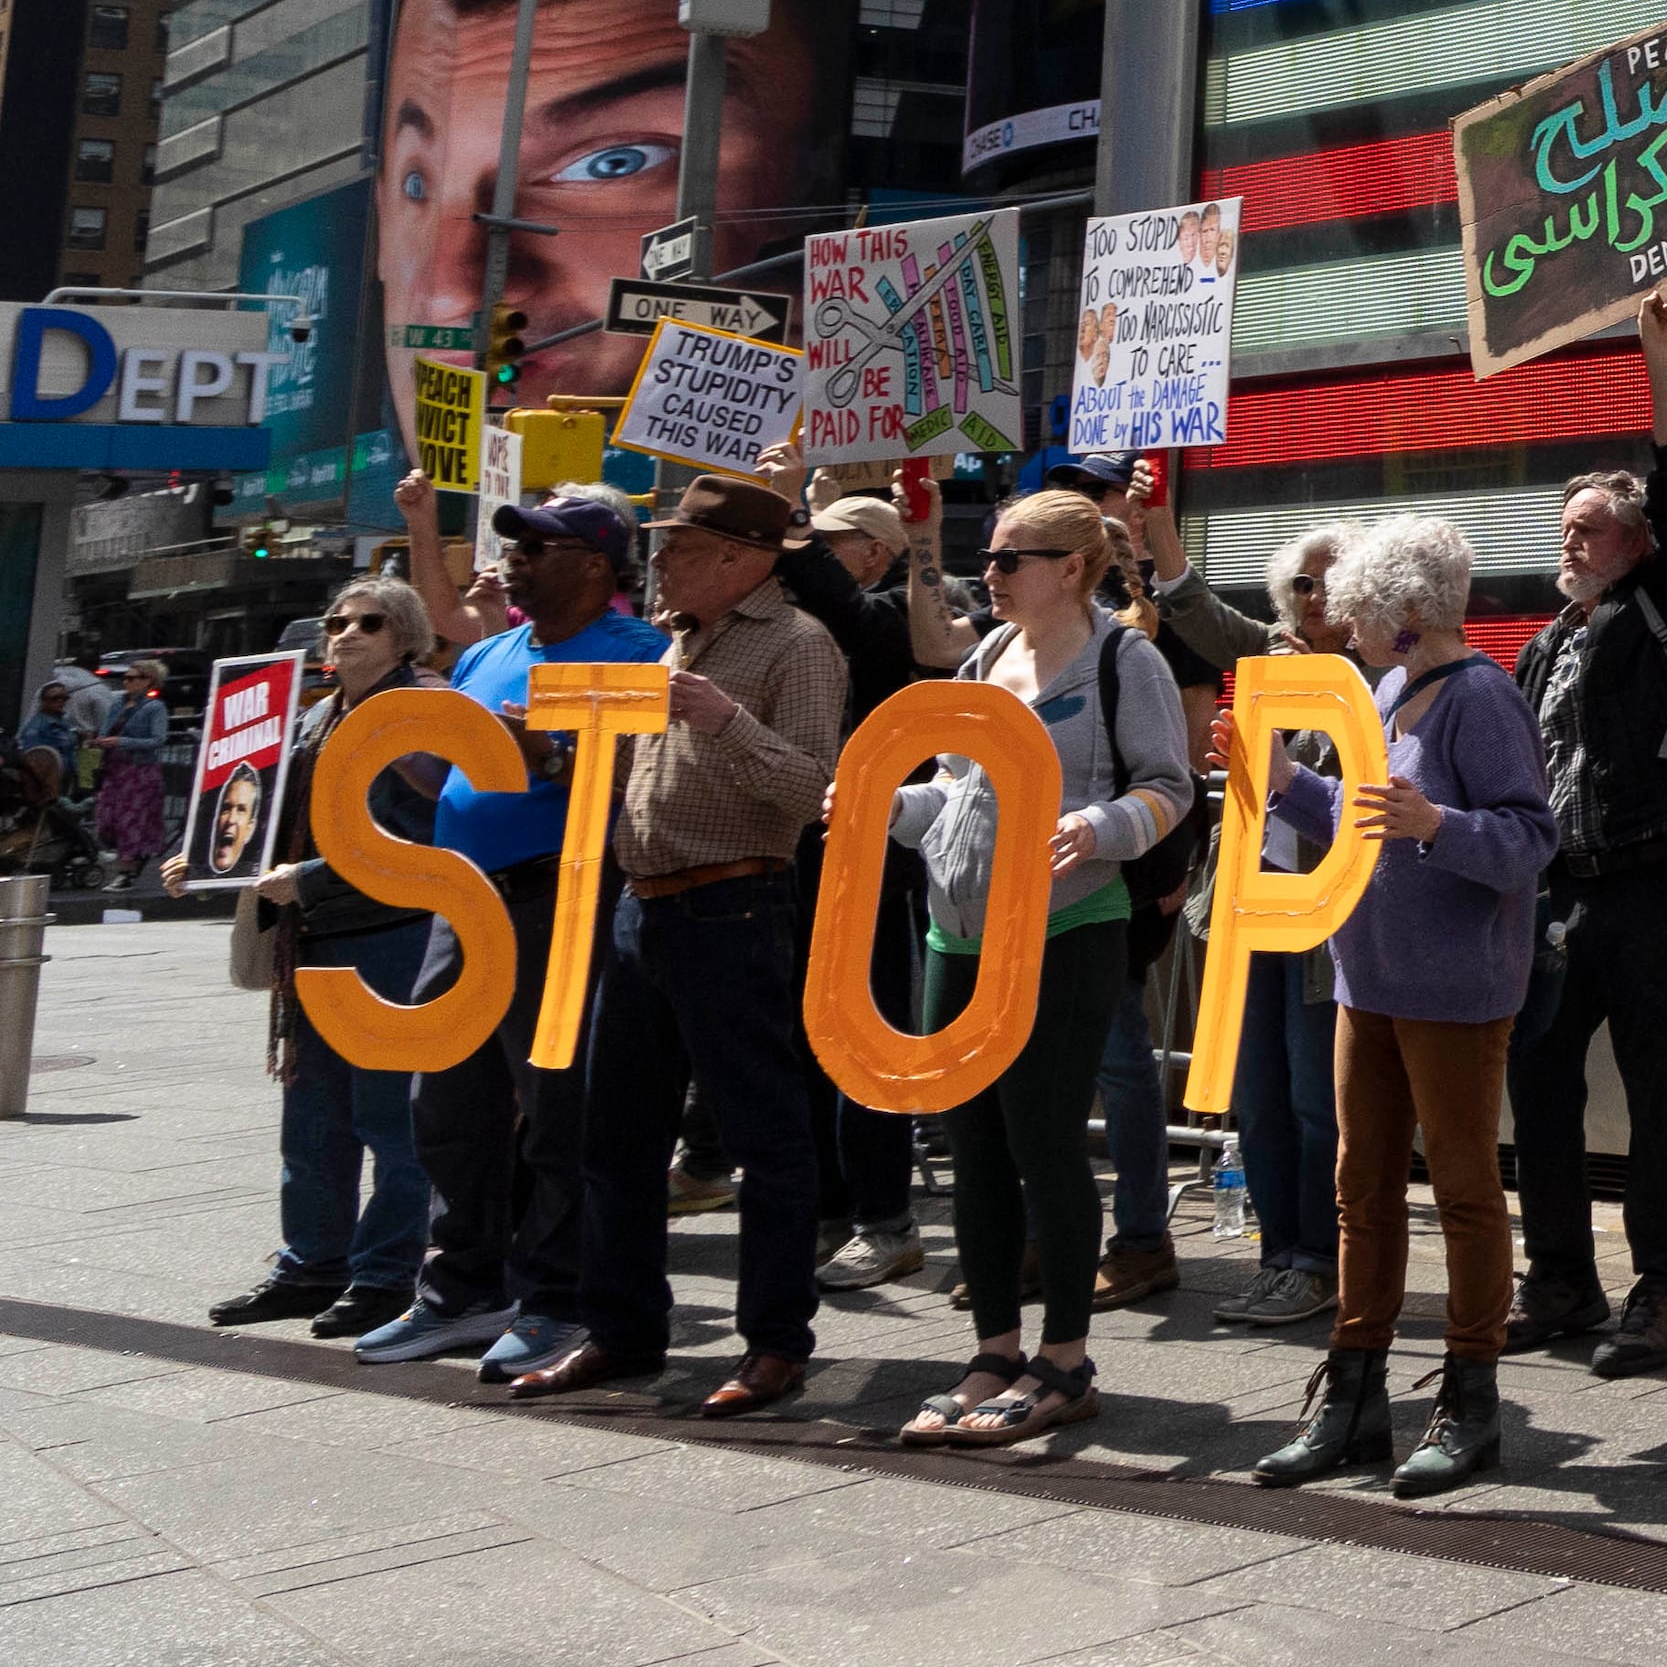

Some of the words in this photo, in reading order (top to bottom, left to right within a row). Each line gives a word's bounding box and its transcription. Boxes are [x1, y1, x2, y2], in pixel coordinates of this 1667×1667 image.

[1068, 107, 1099, 130] CH
[809, 234, 849, 269] HOW
[855, 229, 908, 263] THIS
[1088, 221, 1117, 261] TOO
[1125, 215, 1179, 255] STUPID
[810, 265, 869, 305] WAR
[1084, 265, 1100, 307] TO
[1108, 261, 1195, 300] COMPREHEND
[635, 298, 686, 319] ONE
[710, 305, 763, 330] WAY
[961, 264, 978, 302] DAY
[971, 309, 987, 355] CARE
[1115, 307, 1138, 345] TOO
[1140, 295, 1224, 345] NARCISSISTIC
[431, 329, 454, 347] 43
[675, 330, 798, 383] TRUMP'S
[807, 339, 852, 371] WILL
[883, 286, 920, 397] EDUATION
[908, 283, 934, 398] HALTHCARE
[415, 361, 472, 409] PEACH
[862, 366, 891, 398] BE
[1130, 345, 1148, 381] TO
[654, 359, 797, 414] STUPIDITY
[1074, 380, 1126, 415] ABOUT
[1127, 385, 1145, 411] the
[1151, 373, 1207, 411] DAMAGE
[416, 401, 470, 445] VICT
[662, 393, 763, 436] CAUSED
[809, 408, 861, 448] PAID
[868, 404, 911, 442] FOR
[1073, 414, 1109, 447] DONE
[1114, 419, 1128, 447] by
[1129, 410, 1163, 447] HIS
[1171, 401, 1225, 443] WAR
[645, 415, 699, 448] THIS
[705, 431, 763, 465] WAR
[223, 681, 270, 731] WAR
[207, 715, 282, 770] CRIMINAL
